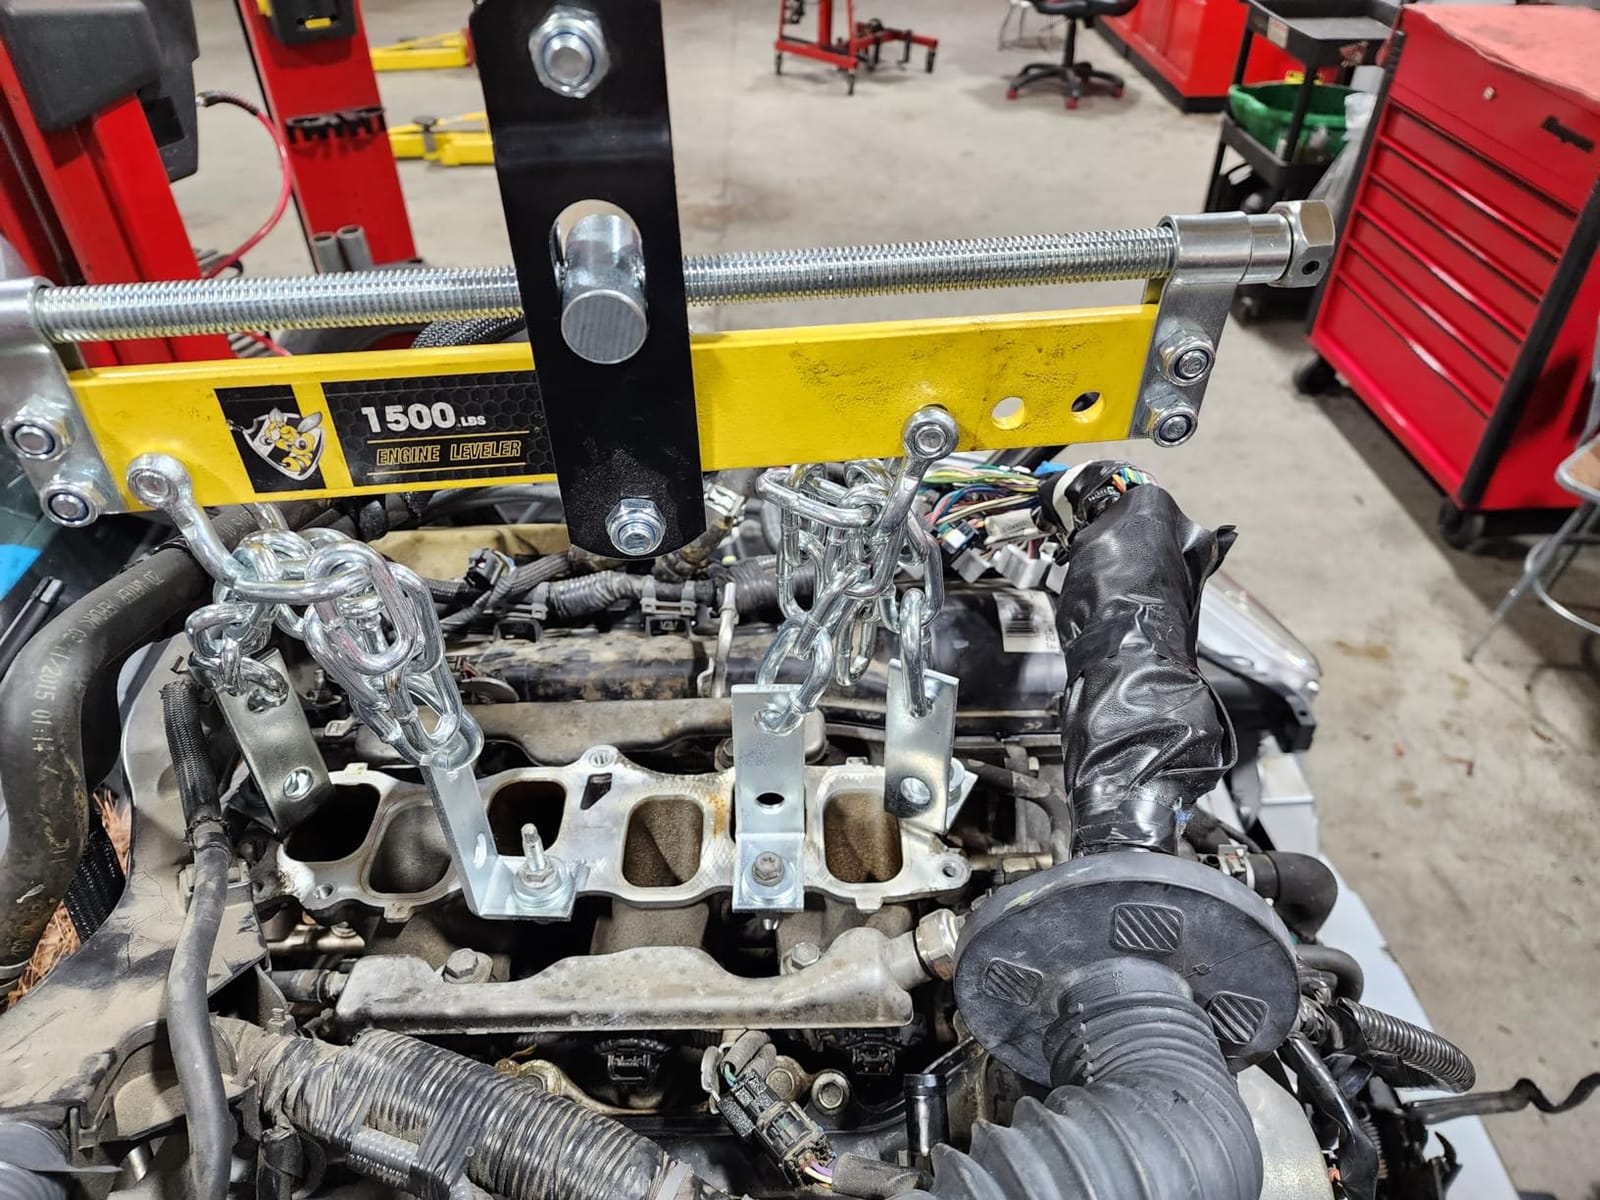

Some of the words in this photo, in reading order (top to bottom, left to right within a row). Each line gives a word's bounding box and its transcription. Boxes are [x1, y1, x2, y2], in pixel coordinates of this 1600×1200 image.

[361, 402, 456, 433] 1500
[376, 445, 440, 466] ENGINE
[450, 440, 522, 461] LEVELER
